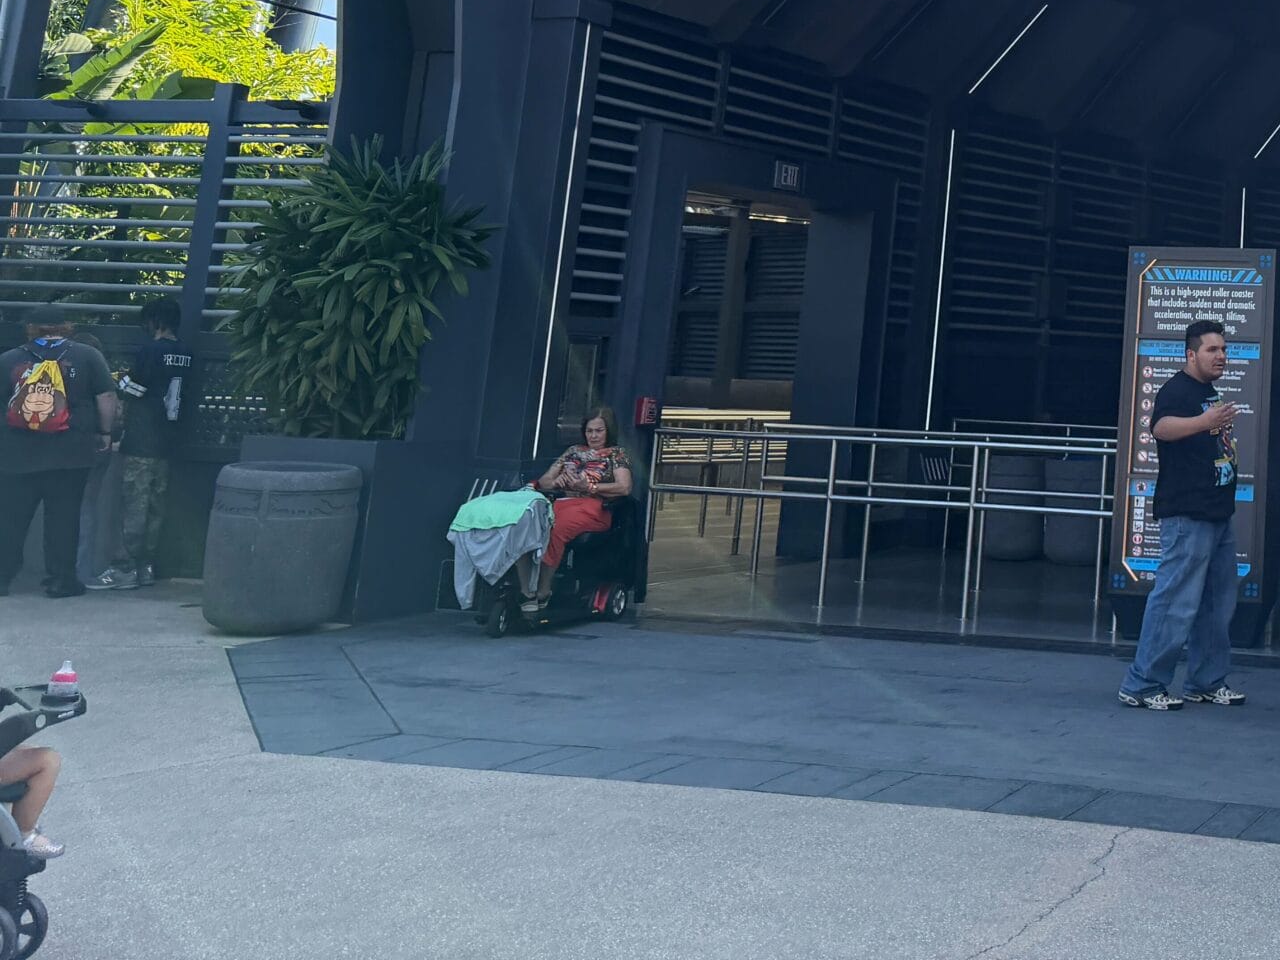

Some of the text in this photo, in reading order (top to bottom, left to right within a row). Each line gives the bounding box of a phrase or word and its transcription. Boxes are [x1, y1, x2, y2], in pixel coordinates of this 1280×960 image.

[782, 165, 799, 186] EXIT
[1174, 268, 1233, 282] WARNING!
[1150, 285, 1163, 296] This
[1164, 286, 1170, 296] is
[1177, 286, 1211, 298] high-speed
[1212, 287, 1230, 297] roller
[1231, 289, 1254, 298] coaster
[1147, 297, 1256, 310] that includes sudden and dramatic
[1154, 309, 1194, 321] acceleration,
